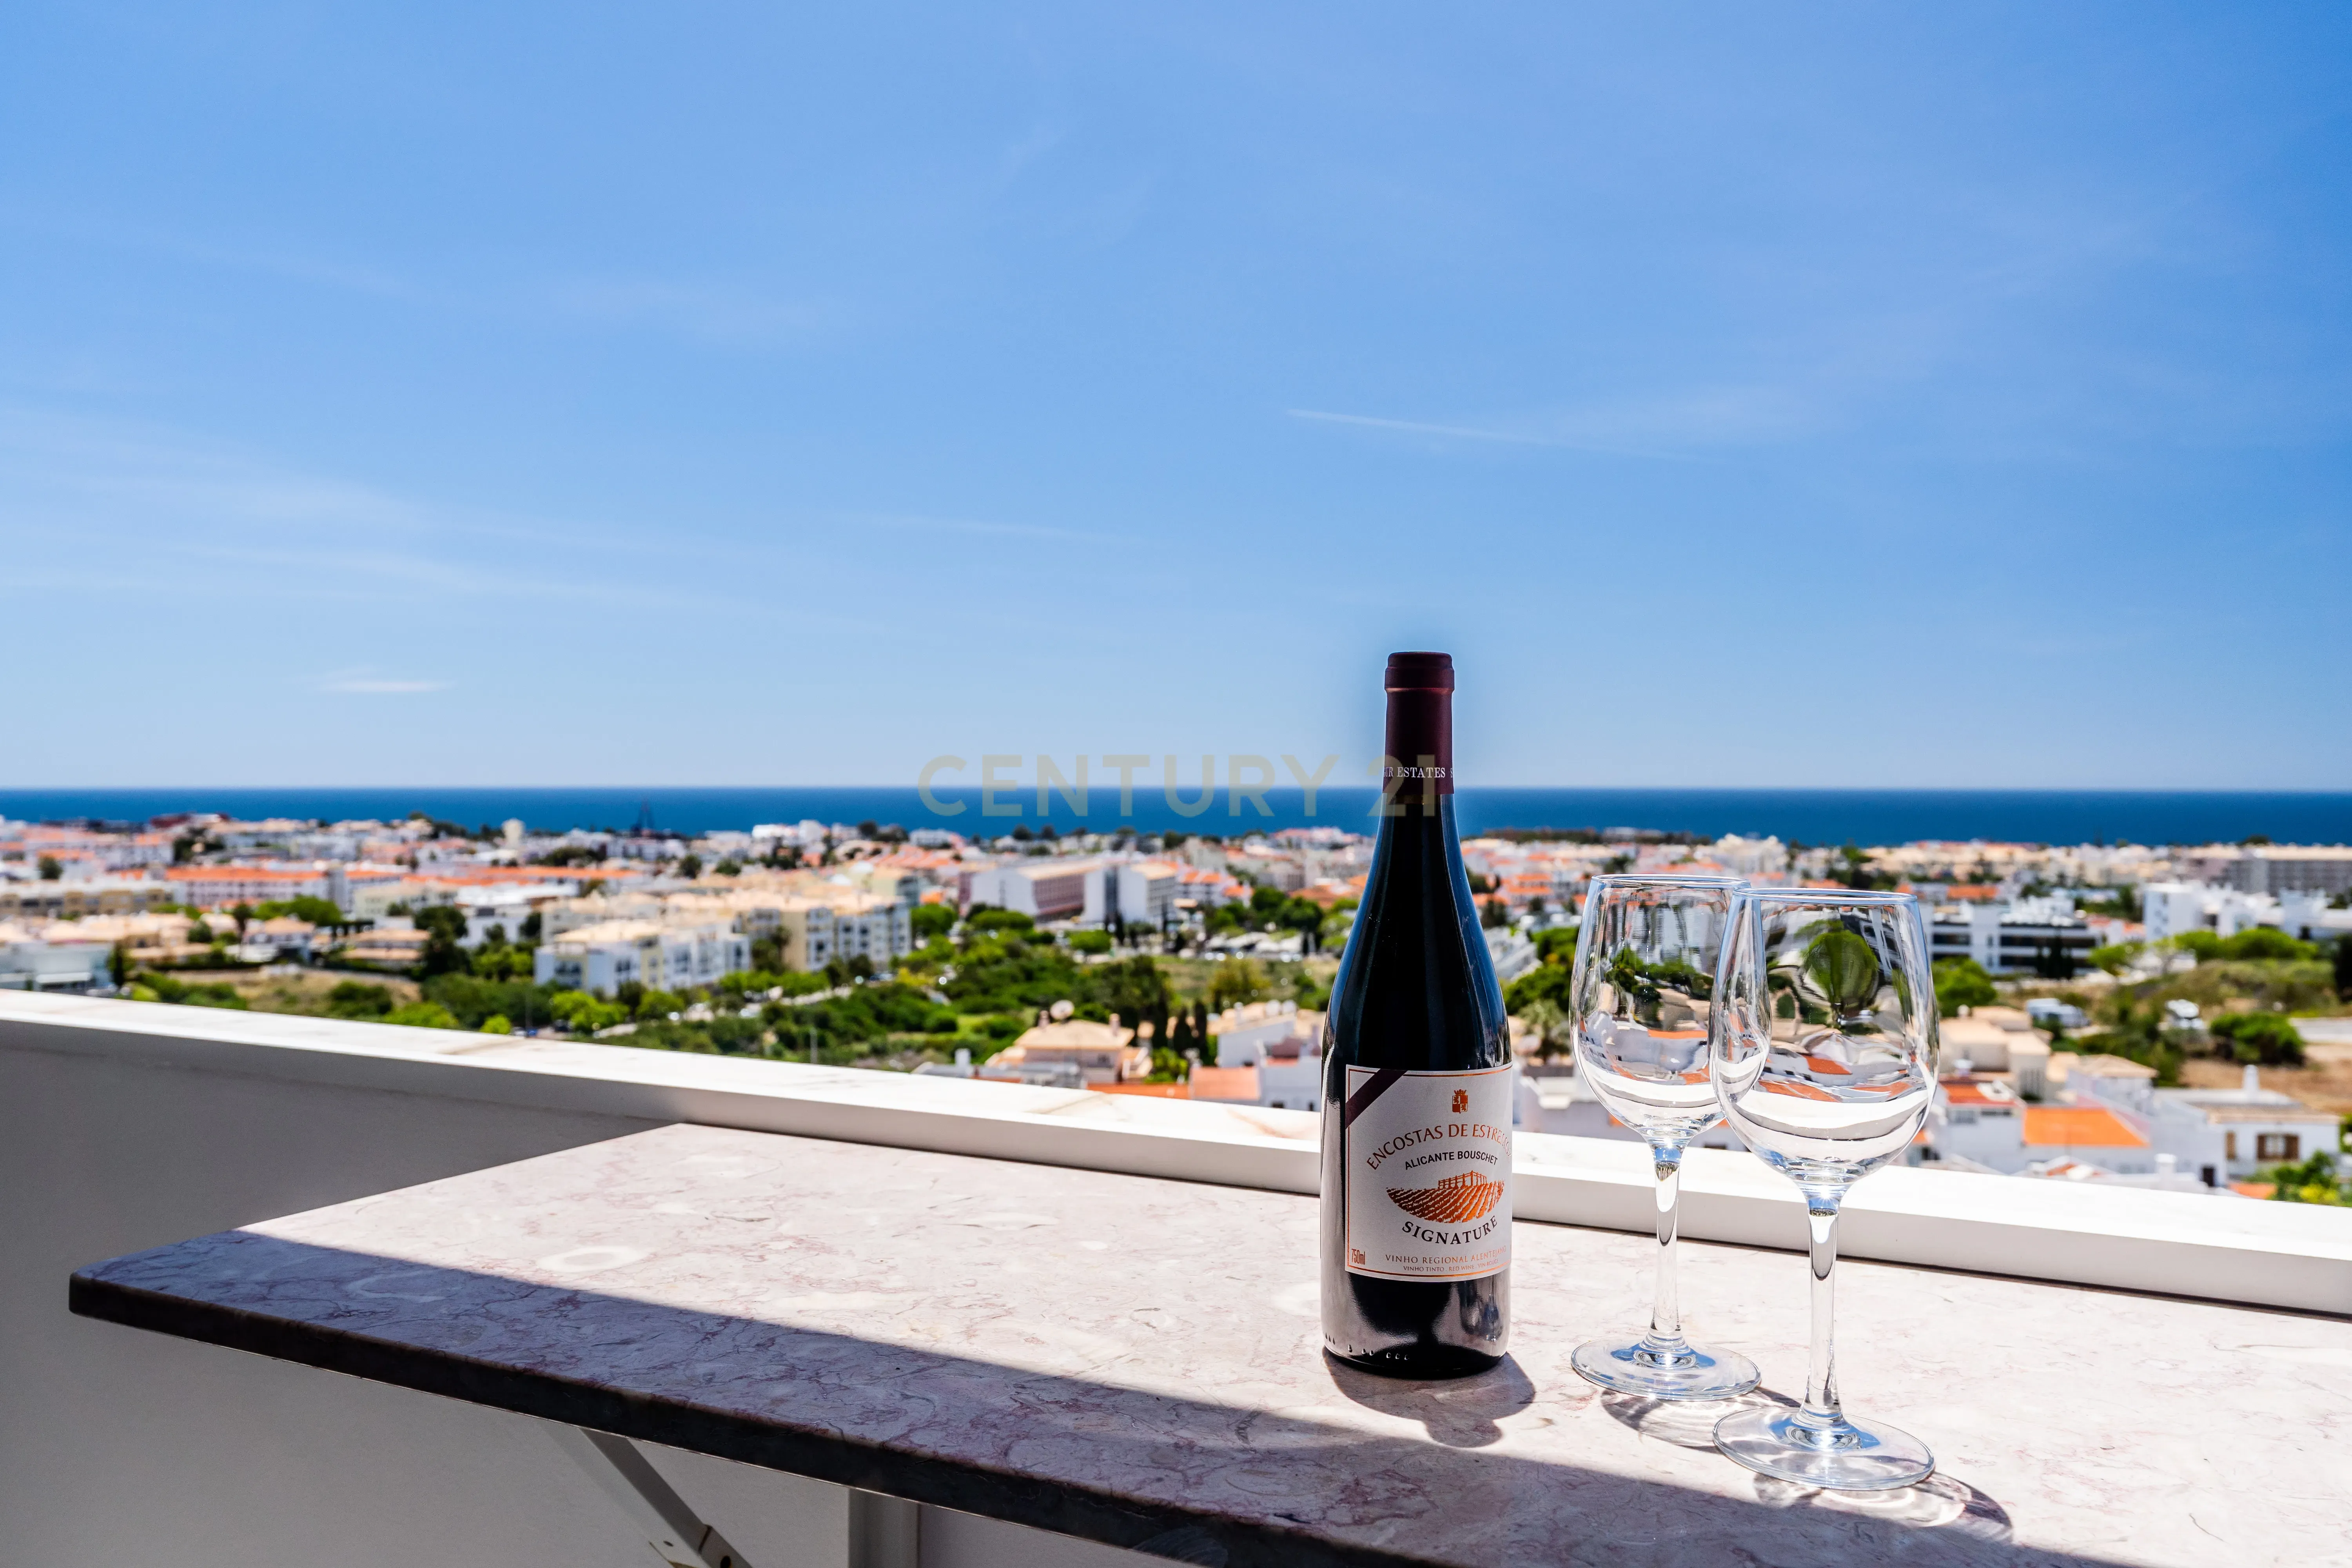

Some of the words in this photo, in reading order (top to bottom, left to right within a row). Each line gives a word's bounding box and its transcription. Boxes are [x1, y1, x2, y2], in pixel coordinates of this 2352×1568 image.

[1397, 767, 1445, 778] ESTATES
[1367, 1125, 1443, 1170] ENCOSTAS
[1448, 1124, 1468, 1137] DE
[1405, 1152, 1454, 1170] ALICANTE
[1457, 1151, 1498, 1165] BOUSCHET
[1402, 1215, 1497, 1245] SIGNATURE
[1351, 1249, 1365, 1265] 750ml
[1385, 1254, 1418, 1263] VINHO
[1423, 1256, 1468, 1264] REGIONAL
[1471, 1245, 1506, 1261] ALENTEJANO
[1487, 1258, 1499, 1267] ROUGE
